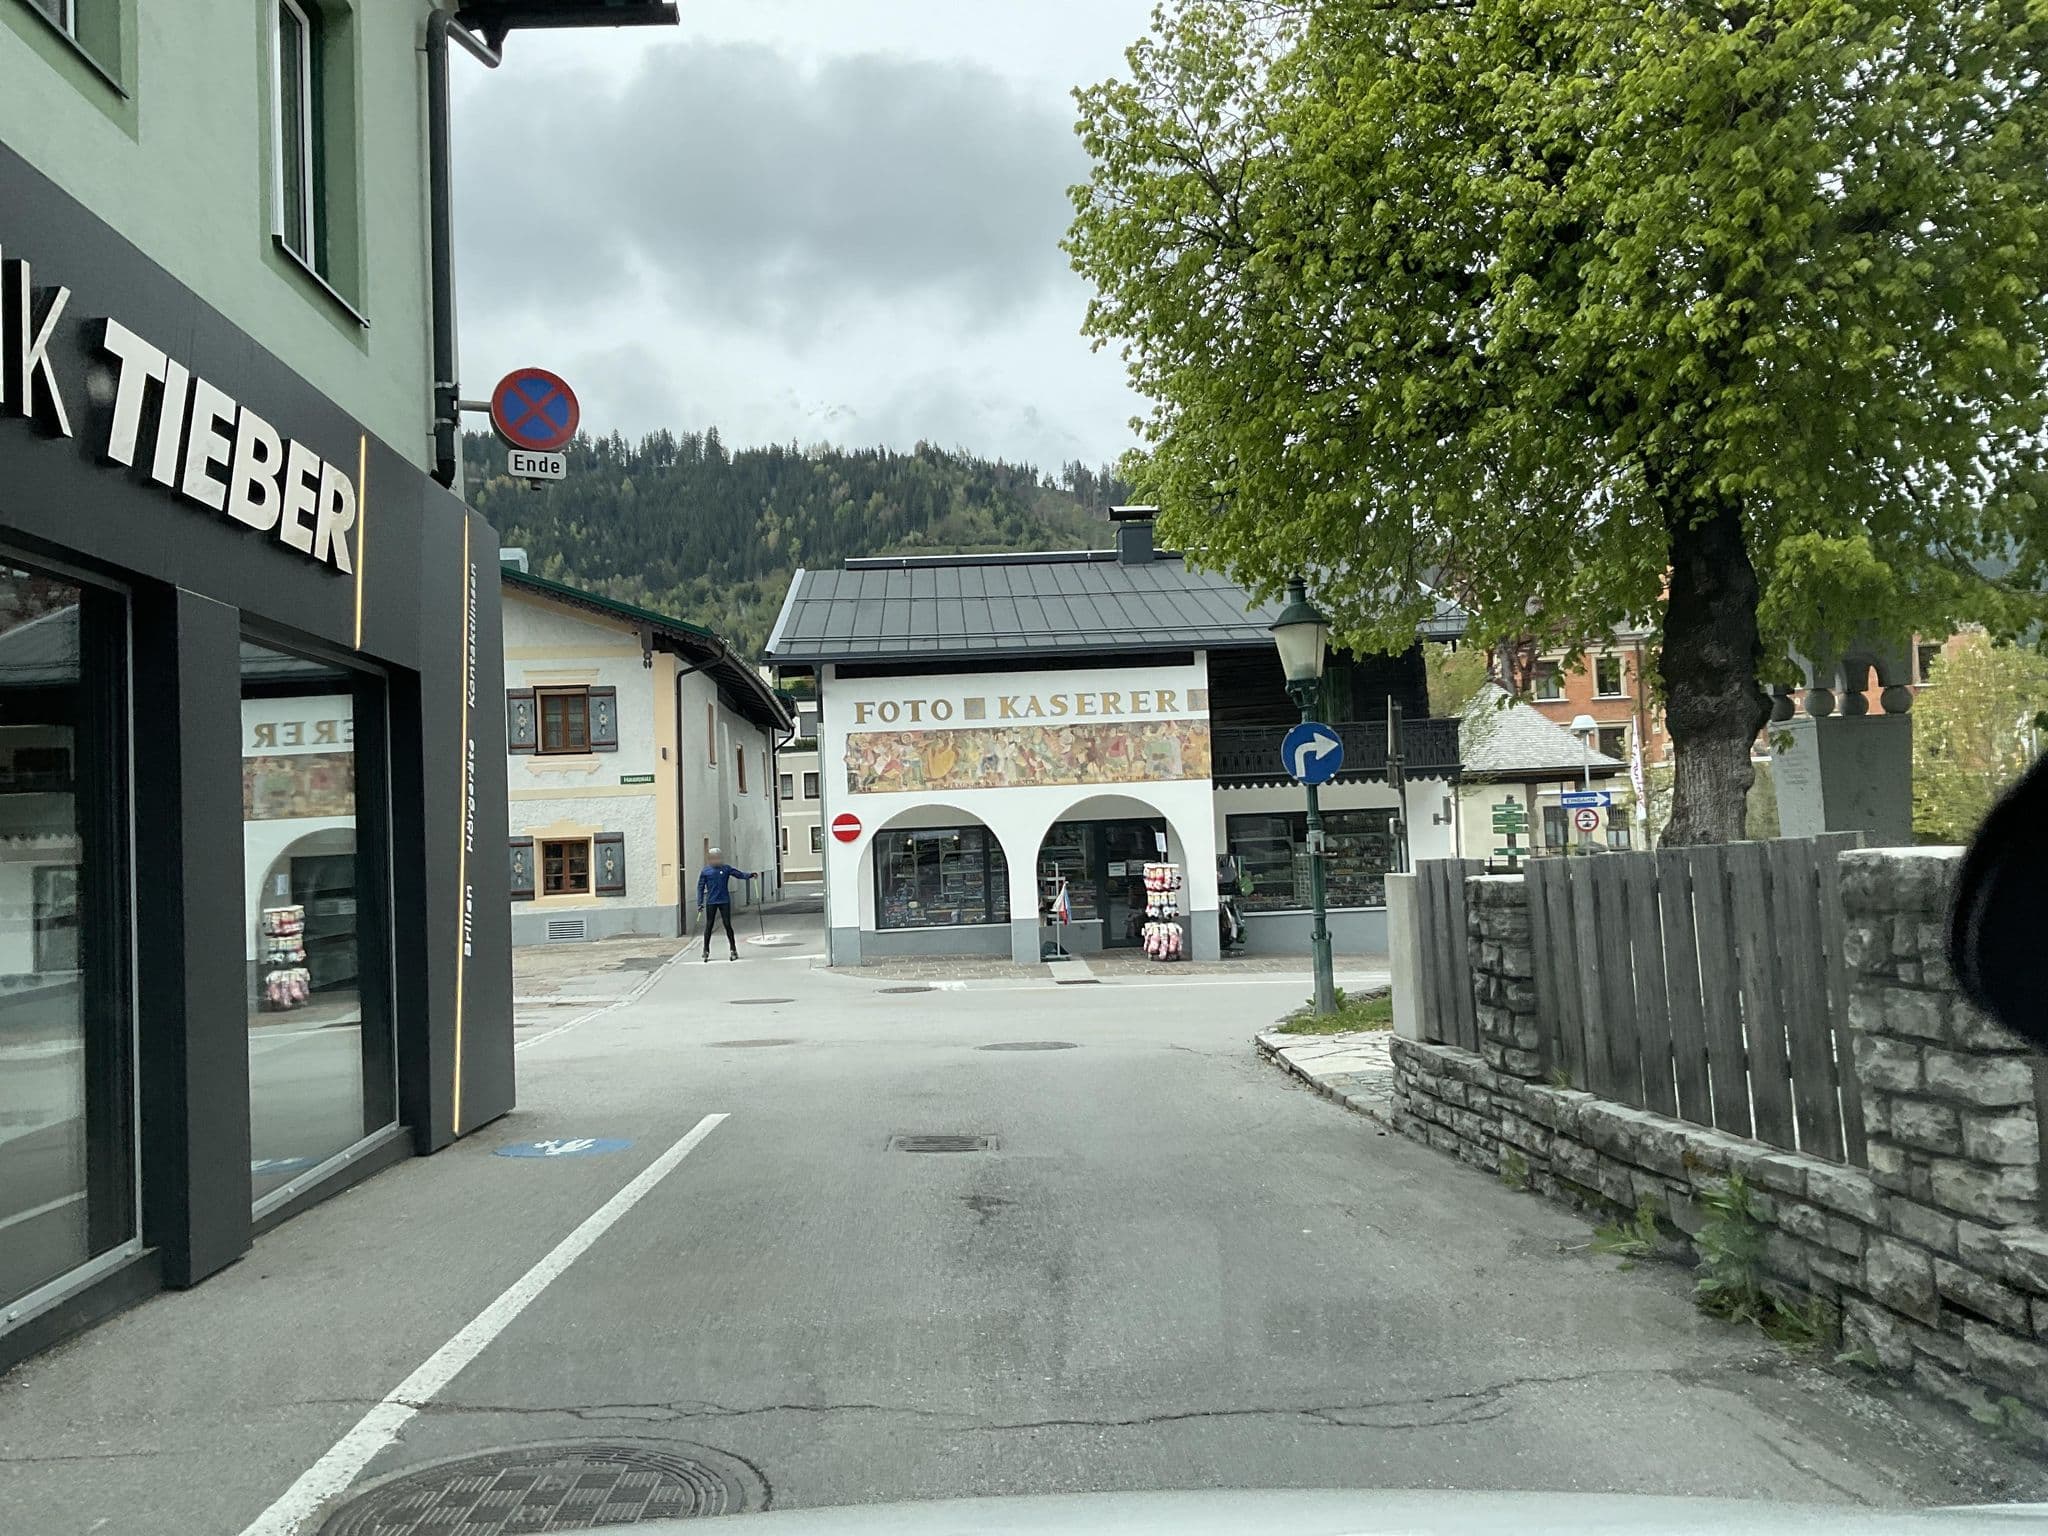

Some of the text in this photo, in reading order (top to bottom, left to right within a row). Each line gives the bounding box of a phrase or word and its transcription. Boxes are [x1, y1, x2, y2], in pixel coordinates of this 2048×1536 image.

[103, 316, 357, 576] TIEBER
[514, 454, 560, 474] Ende
[467, 562, 477, 709] Kontaktlinsen
[854, 689, 1179, 725] FOTO KASERER
[463, 884, 473, 957] Brillen
